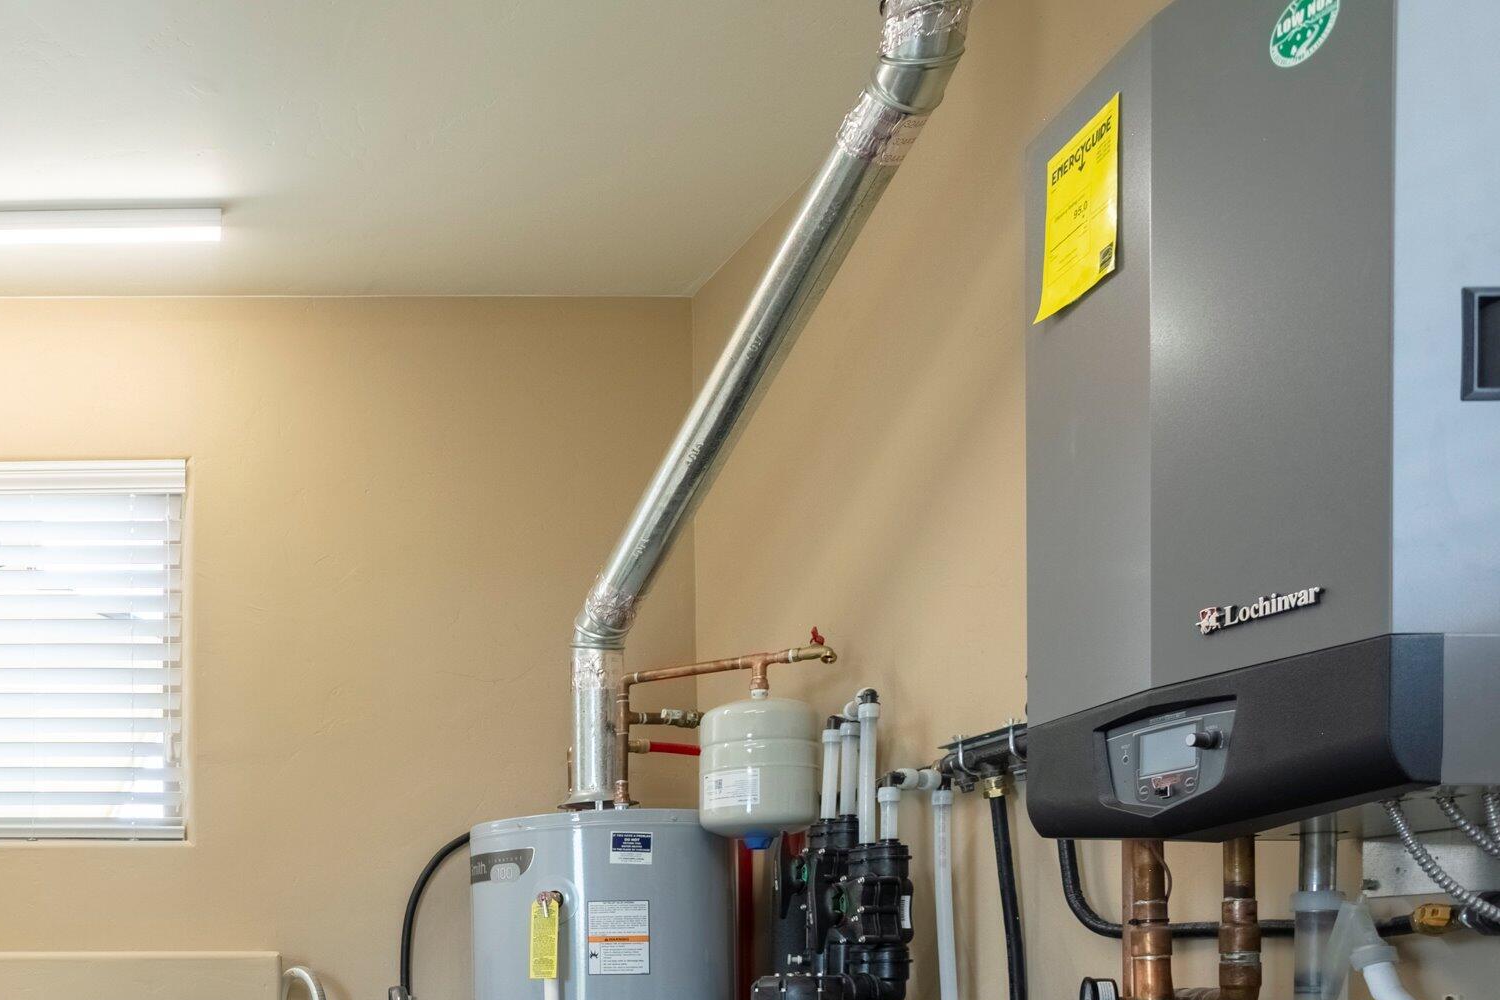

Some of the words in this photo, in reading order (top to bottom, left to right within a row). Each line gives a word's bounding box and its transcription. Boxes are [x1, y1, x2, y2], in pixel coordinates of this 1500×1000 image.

[1277, 8, 1305, 38] LOW
[1051, 115, 1113, 186] ENERGYGUIDE
[1223, 586, 1321, 627] Lochinvar
